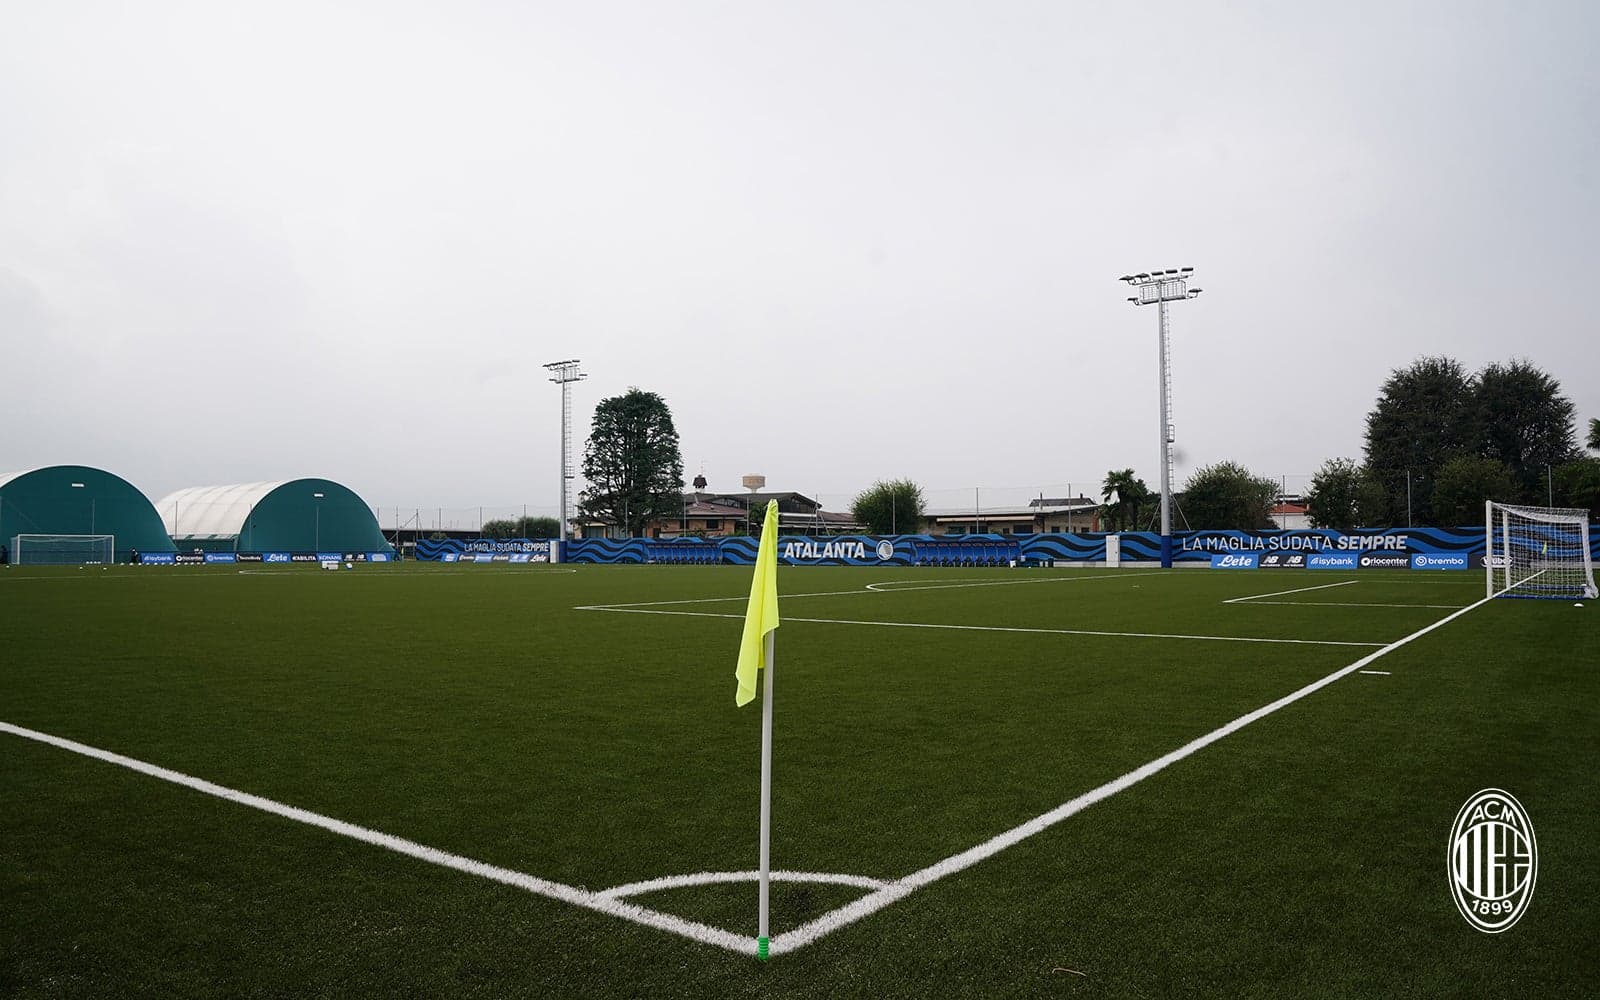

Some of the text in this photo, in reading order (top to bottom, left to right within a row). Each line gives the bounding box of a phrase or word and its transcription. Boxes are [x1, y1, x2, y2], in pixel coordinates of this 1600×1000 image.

[473, 543, 496, 552] MAGLIA
[497, 543, 521, 552] SUDATA
[522, 543, 549, 552] SEMPRE
[1182, 535, 1408, 551] LA MAGLIA SUDATA SEMPRE
[783, 542, 866, 559] ATALANTA
[1217, 555, 1253, 567] Lete
[1319, 557, 1353, 566] isybank
